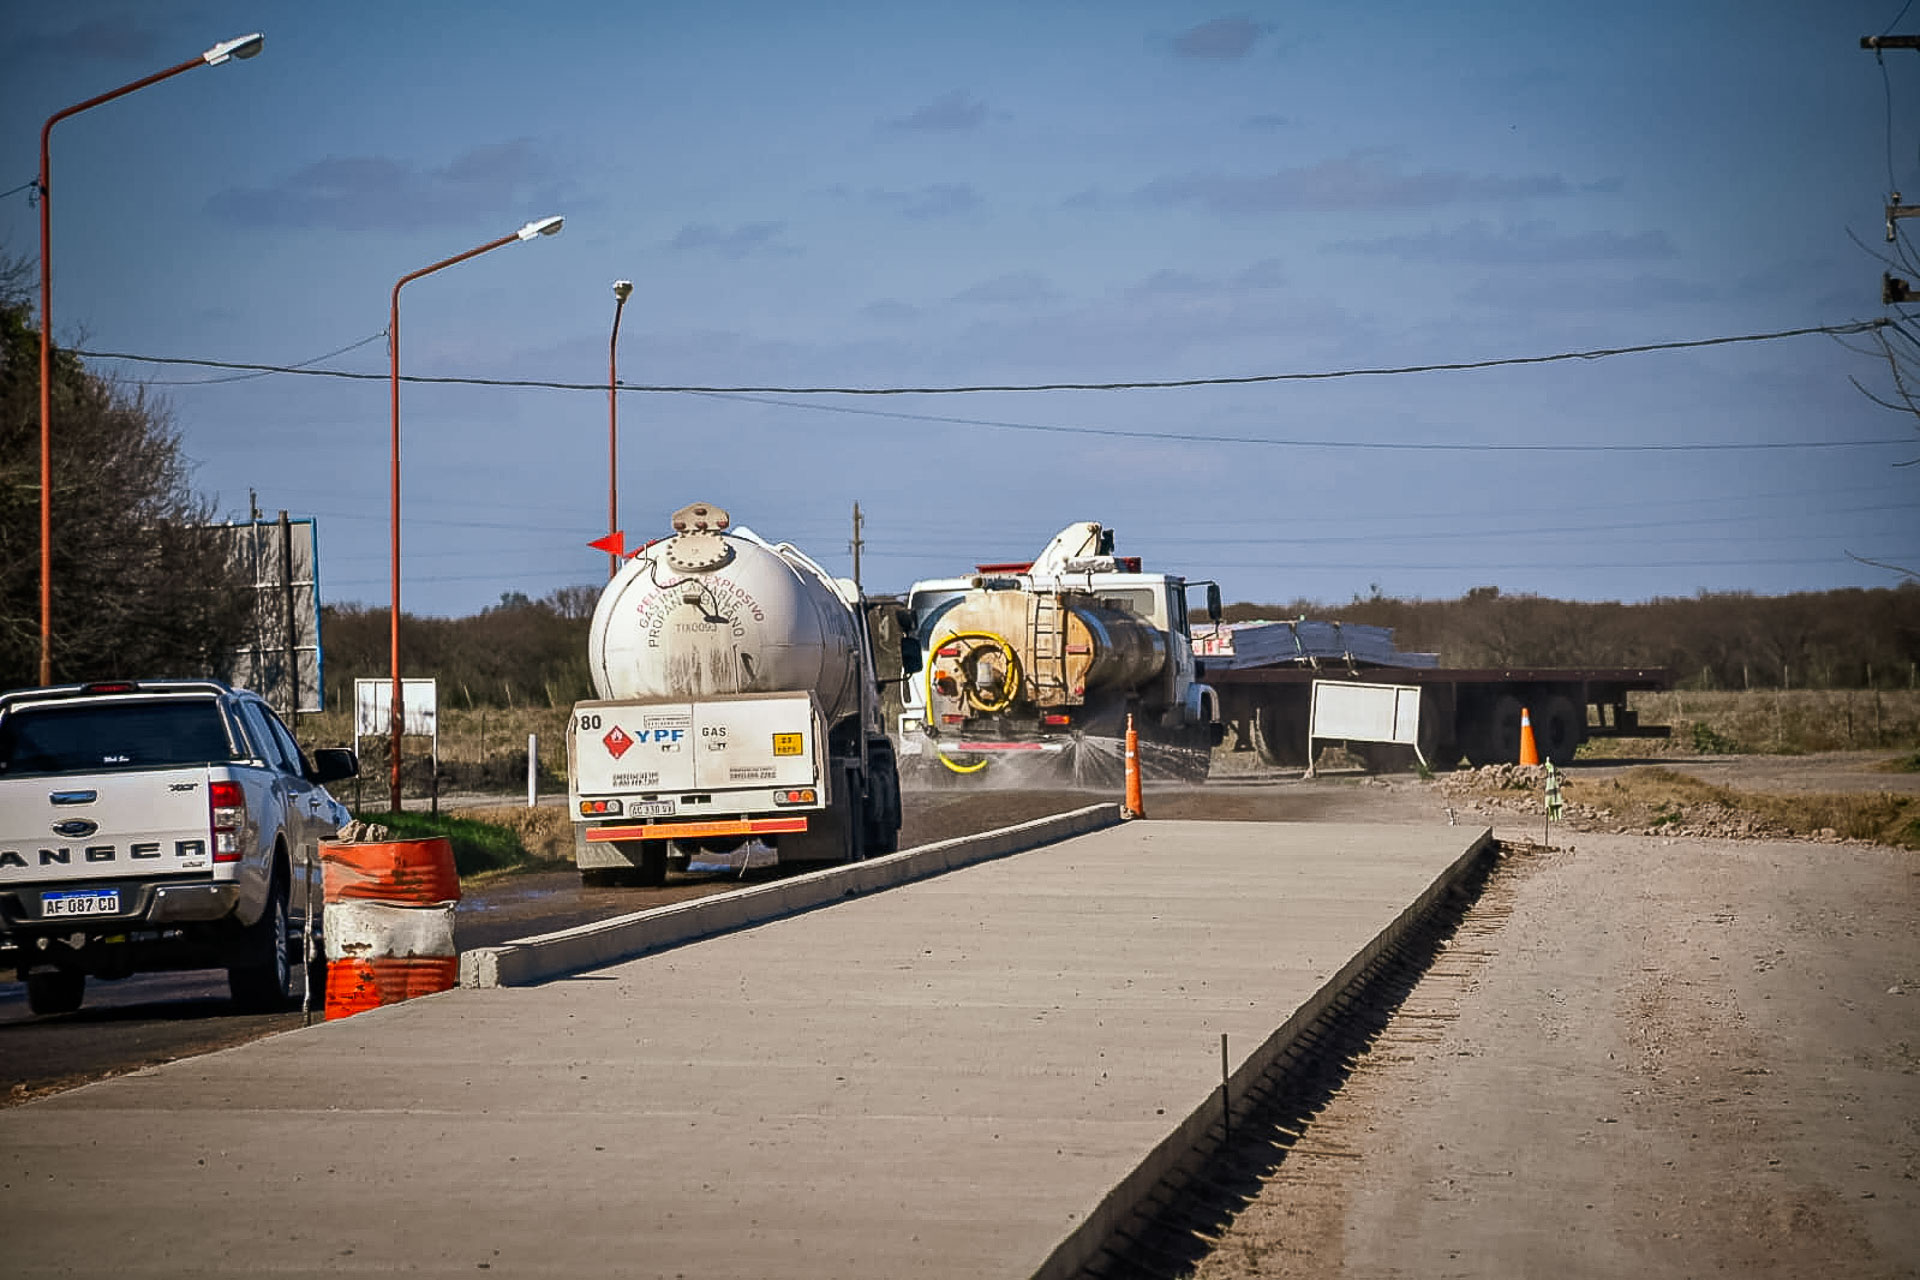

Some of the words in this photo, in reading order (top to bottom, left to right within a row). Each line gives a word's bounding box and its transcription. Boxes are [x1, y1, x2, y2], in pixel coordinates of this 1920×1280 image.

[637, 576, 688, 614] PELIGR
[703, 575, 765, 622] EXPLOSIVO
[640, 604, 660, 628] GAS
[648, 597, 684, 648] PROPAN
[581, 715, 601, 730] 80
[635, 729, 684, 743] YPF
[702, 727, 726, 736] GAS
[47, 901, 64, 914] AF
[68, 898, 94, 913] 087
[99, 897, 116, 911] CD
